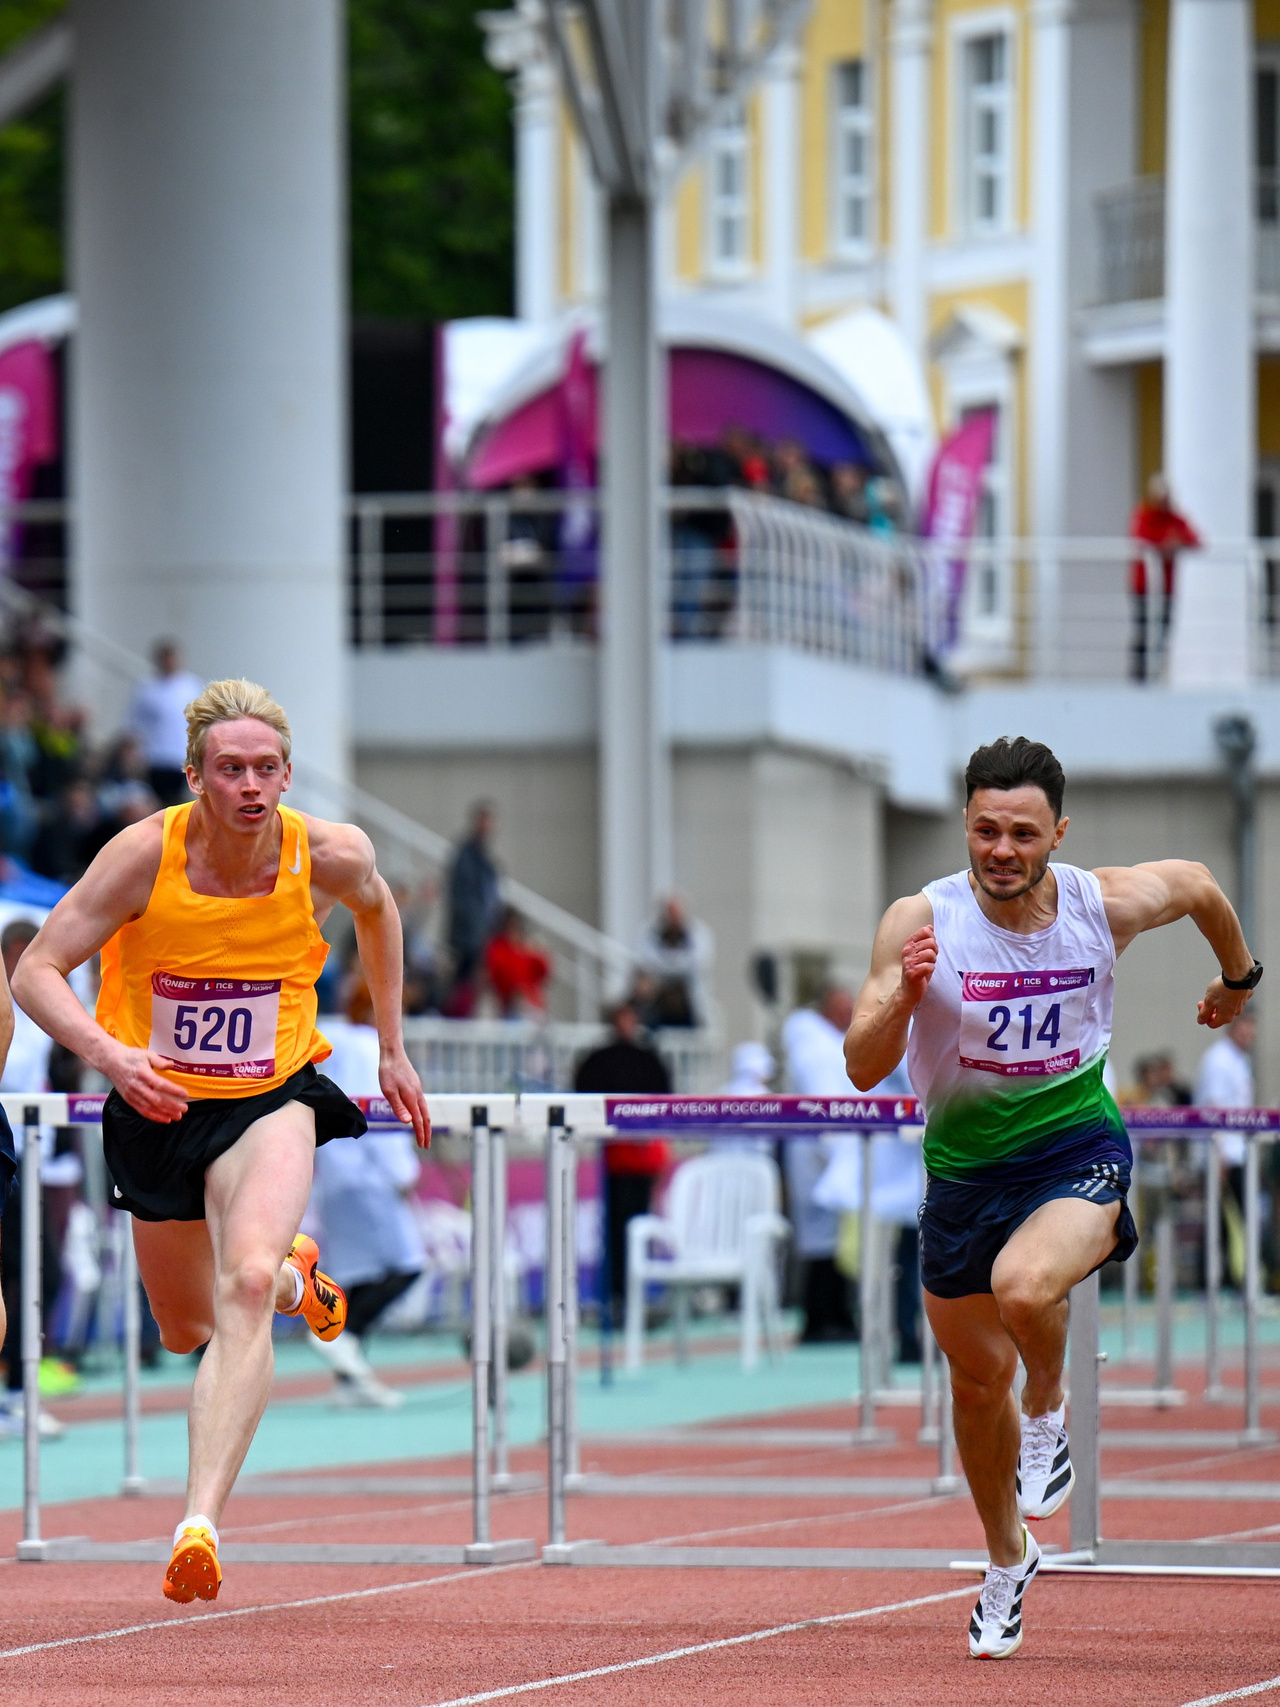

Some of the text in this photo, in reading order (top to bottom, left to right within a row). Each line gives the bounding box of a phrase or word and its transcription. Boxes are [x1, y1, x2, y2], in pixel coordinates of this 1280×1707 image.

[160, 978, 197, 990] FONBET
[215, 982, 234, 990] ПСБ
[969, 979, 1007, 988] FONBET
[1023, 978, 1042, 986] ПСБ
[173, 1004, 253, 1054] 520
[986, 1003, 1061, 1051] 214
[1045, 1057, 1074, 1068] FONBET
[233, 1066, 268, 1074] FONBET
[613, 1101, 782, 1117] FONBET КУБОК РОССИИ
[829, 1101, 880, 1118] ВФЛА
